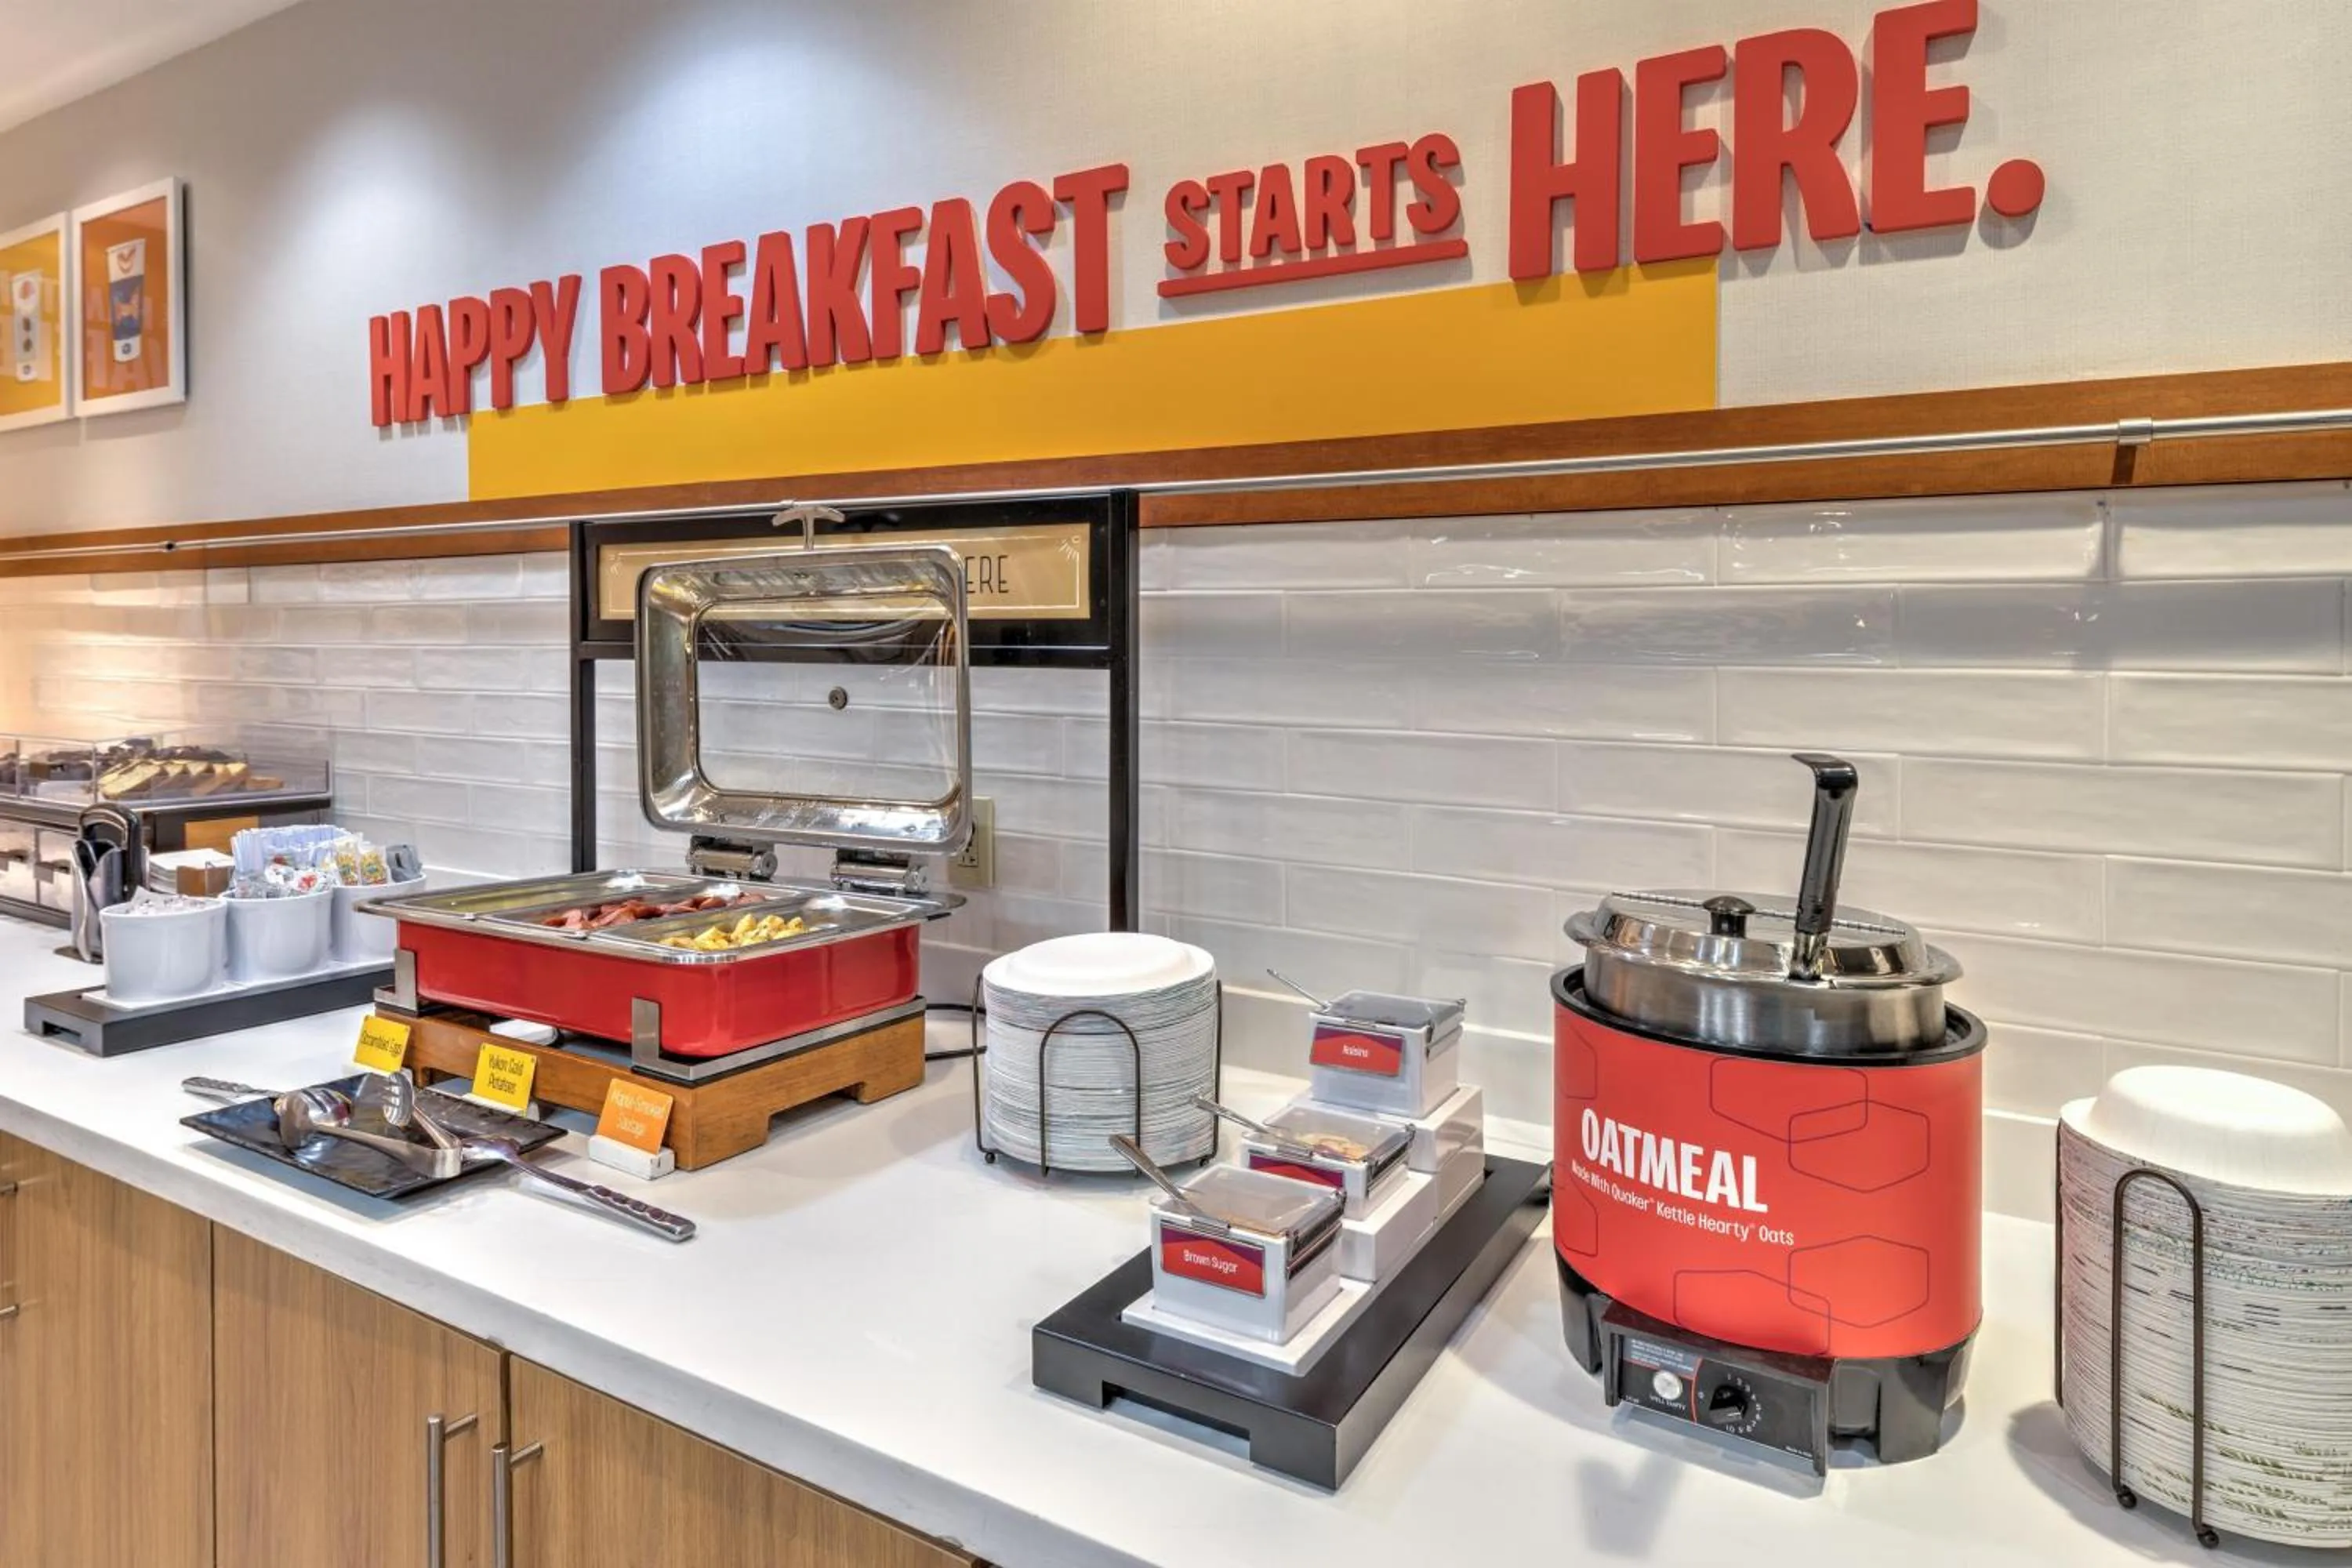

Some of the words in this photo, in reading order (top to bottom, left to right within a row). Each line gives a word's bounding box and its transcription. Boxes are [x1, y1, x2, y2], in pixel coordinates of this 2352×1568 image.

[370, 274, 582, 426] HAPPY
[601, 163, 1129, 396] BREAKFAST
[1163, 132, 1461, 270] STARTS
[1508, 0, 2045, 281] HERE.
[965, 555, 1010, 593] ERE
[1571, 1160, 1590, 1183] Made
[1590, 1172, 1610, 1195] With
[1656, 1200, 1696, 1226] Kettle
[1759, 1225, 1795, 1246] Oats
[1581, 1108, 1769, 1213] OATMEAL
[1182, 1248, 1211, 1266] Brown
[1211, 1256, 1239, 1275] Sugar
